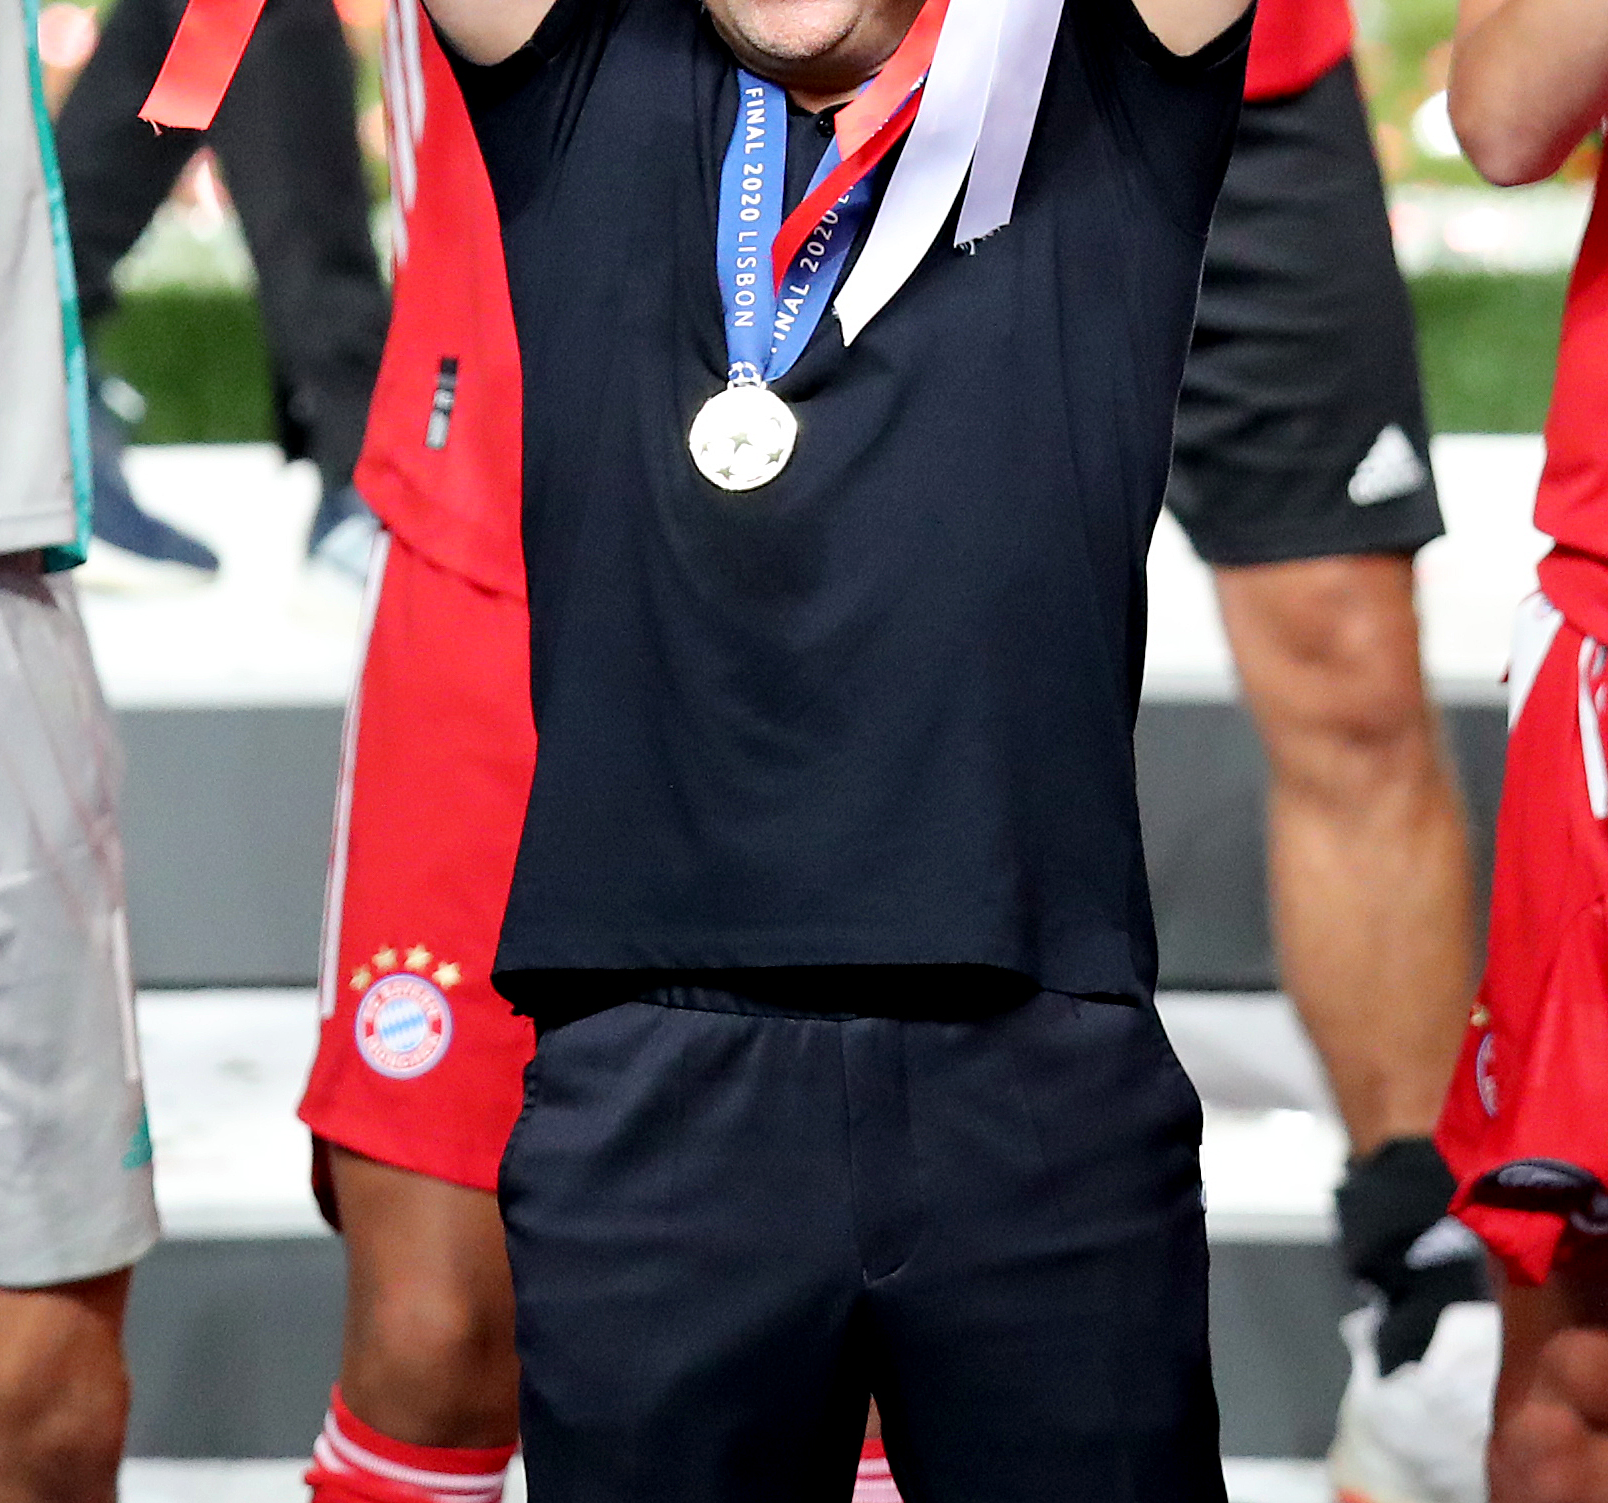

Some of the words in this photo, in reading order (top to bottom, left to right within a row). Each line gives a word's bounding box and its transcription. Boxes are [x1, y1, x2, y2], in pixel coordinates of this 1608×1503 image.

[745, 87, 766, 155] FINAL
[739, 163, 763, 222] 2020
[734, 231, 759, 328] LISBON
[771, 283, 810, 353] INAL
[800, 210, 839, 274] 2020
